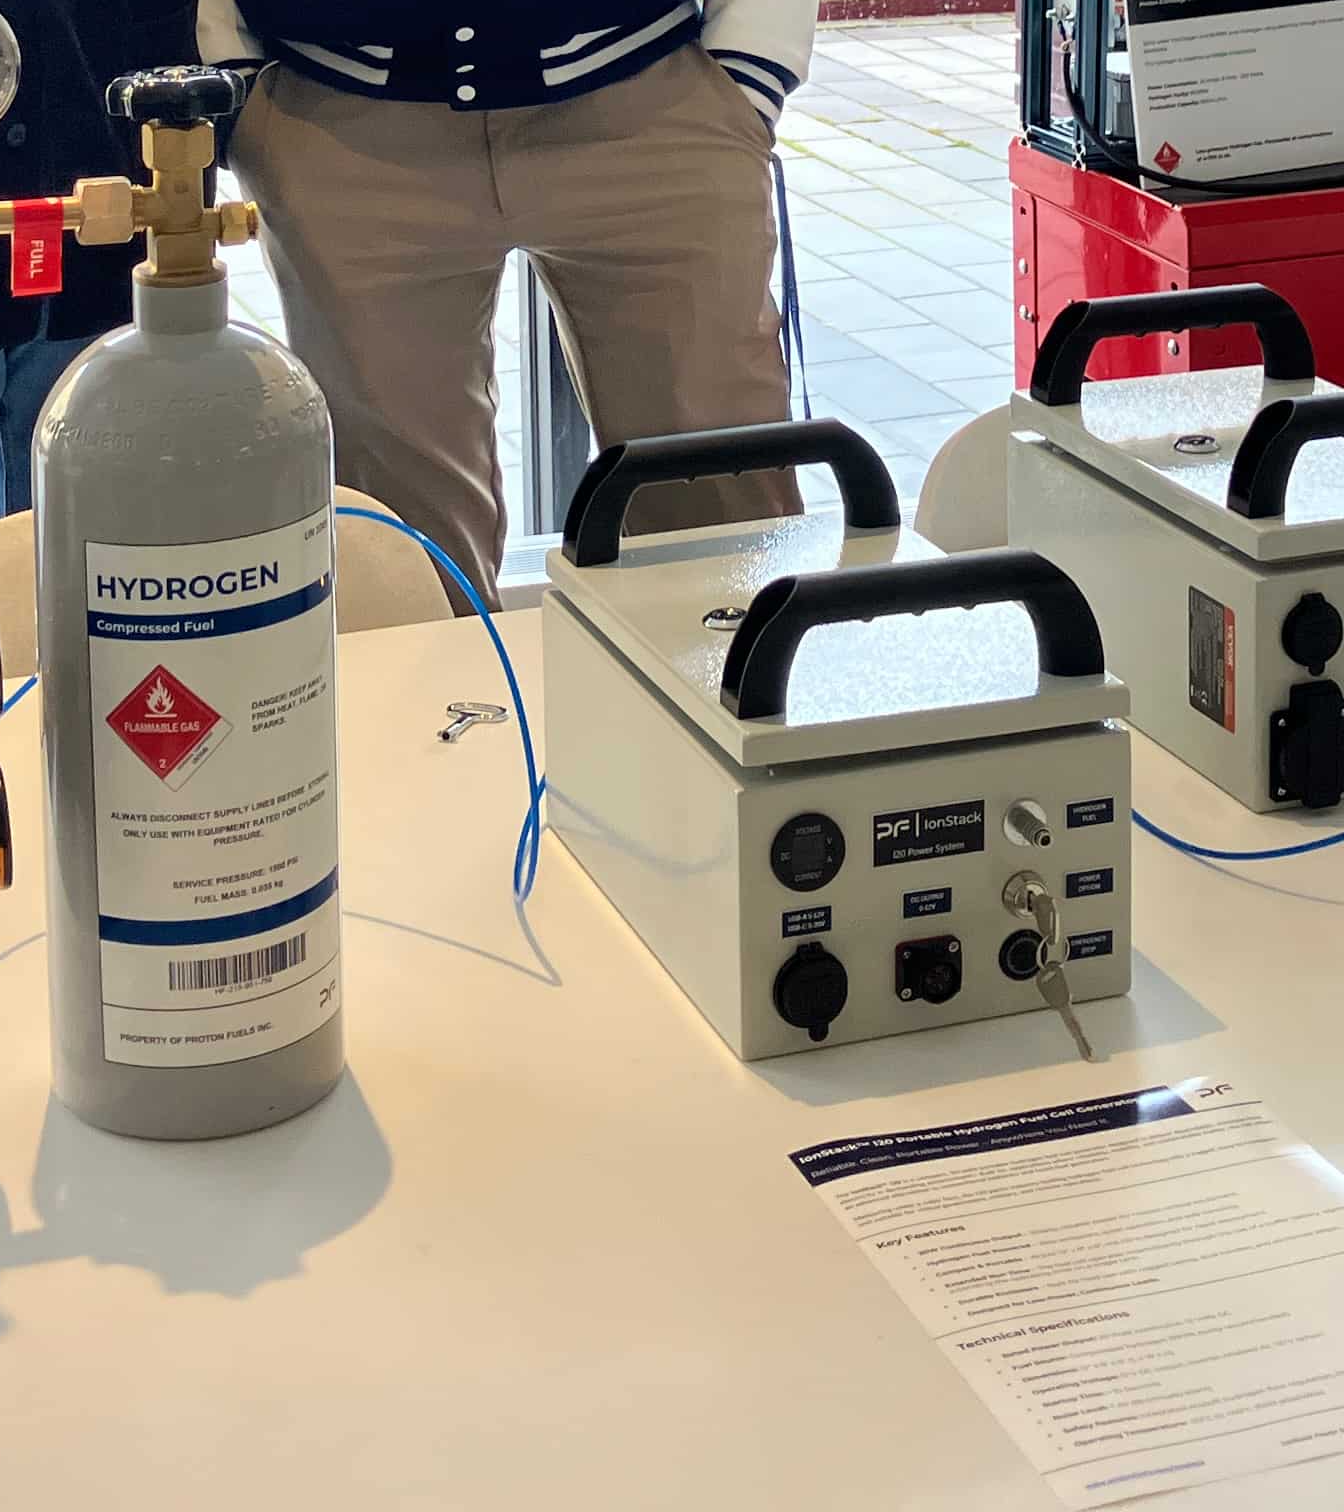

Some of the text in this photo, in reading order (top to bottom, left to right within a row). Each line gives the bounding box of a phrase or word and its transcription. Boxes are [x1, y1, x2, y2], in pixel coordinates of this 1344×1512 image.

[30, 239, 45, 279] FULL
[96, 561, 280, 601] HYDROGEN
[96, 618, 215, 636] Compressed Fuel
[251, 708, 276, 720] FROM
[124, 720, 200, 733] FLAMMABLE GAS
[159, 759, 167, 769] 2
[111, 786, 305, 823] ALWAYS DISCONNECT SUPPLY LINES BEFORE
[123, 829, 146, 838] ONLY
[149, 829, 168, 839] USE
[171, 829, 195, 839] WITH
[197, 821, 251, 836] EQUIPMENT
[253, 812, 280, 827] RATED
[281, 806, 297, 818] FOR
[924, 810, 982, 831] IonStack
[907, 845, 933, 857] Power
[935, 841, 965, 855] System
[173, 878, 213, 889] SERVICE
[216, 869, 265, 885] PRESSURE:
[194, 894, 219, 905] FUEL
[221, 890, 249, 902] MASS:
[274, 879, 284, 890] kg
[120, 1033, 168, 1046] PROPERTY
[170, 1036, 182, 1045] OF
[184, 1033, 225, 1044] PROTON
[226, 1026, 256, 1040] FUELS
[897, 1132, 952, 1144] Portable
[954, 1120, 1019, 1137] Hydrogen
[1019, 1113, 1048, 1125] Fuel
[1049, 1108, 1074, 1119] Cell
[875, 1224, 966, 1249] Key Features
[956, 1311, 1131, 1352] Technical Specifications
